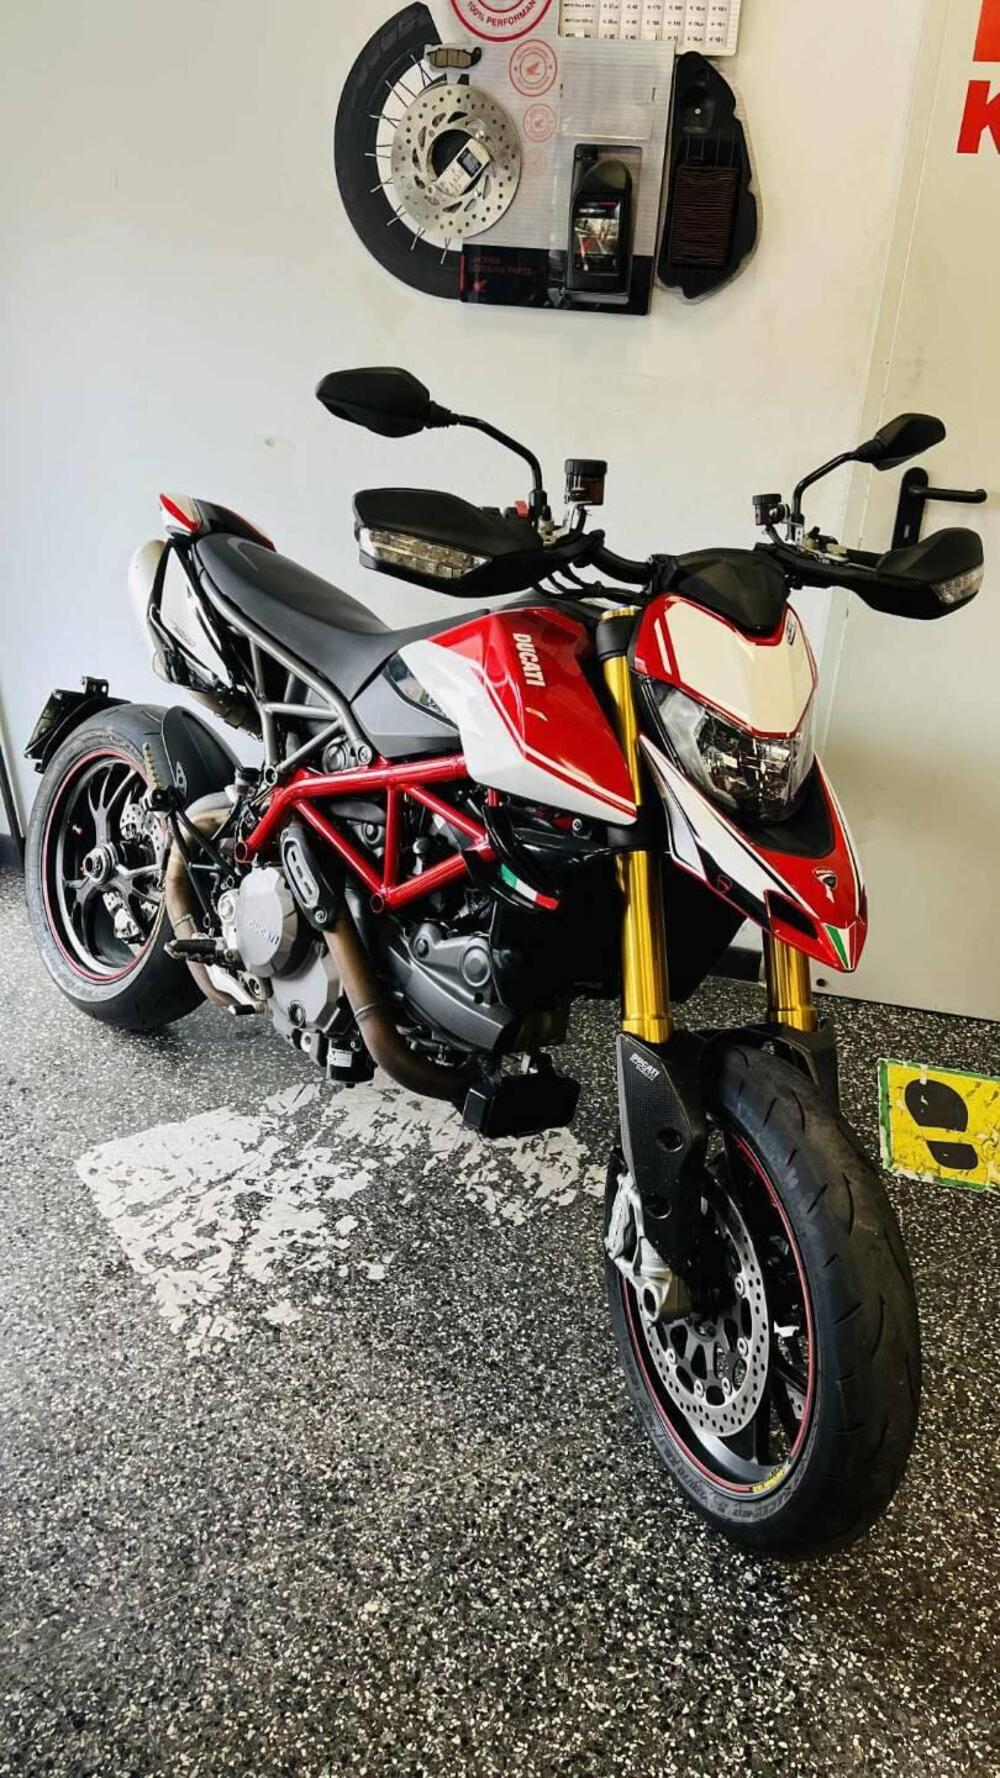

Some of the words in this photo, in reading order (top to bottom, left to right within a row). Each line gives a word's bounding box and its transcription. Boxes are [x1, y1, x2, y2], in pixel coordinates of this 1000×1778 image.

[467, 1, 485, 21] 100%
[512, 632, 546, 687] DUCATI
[629, 1053, 660, 1077] DUCATI
